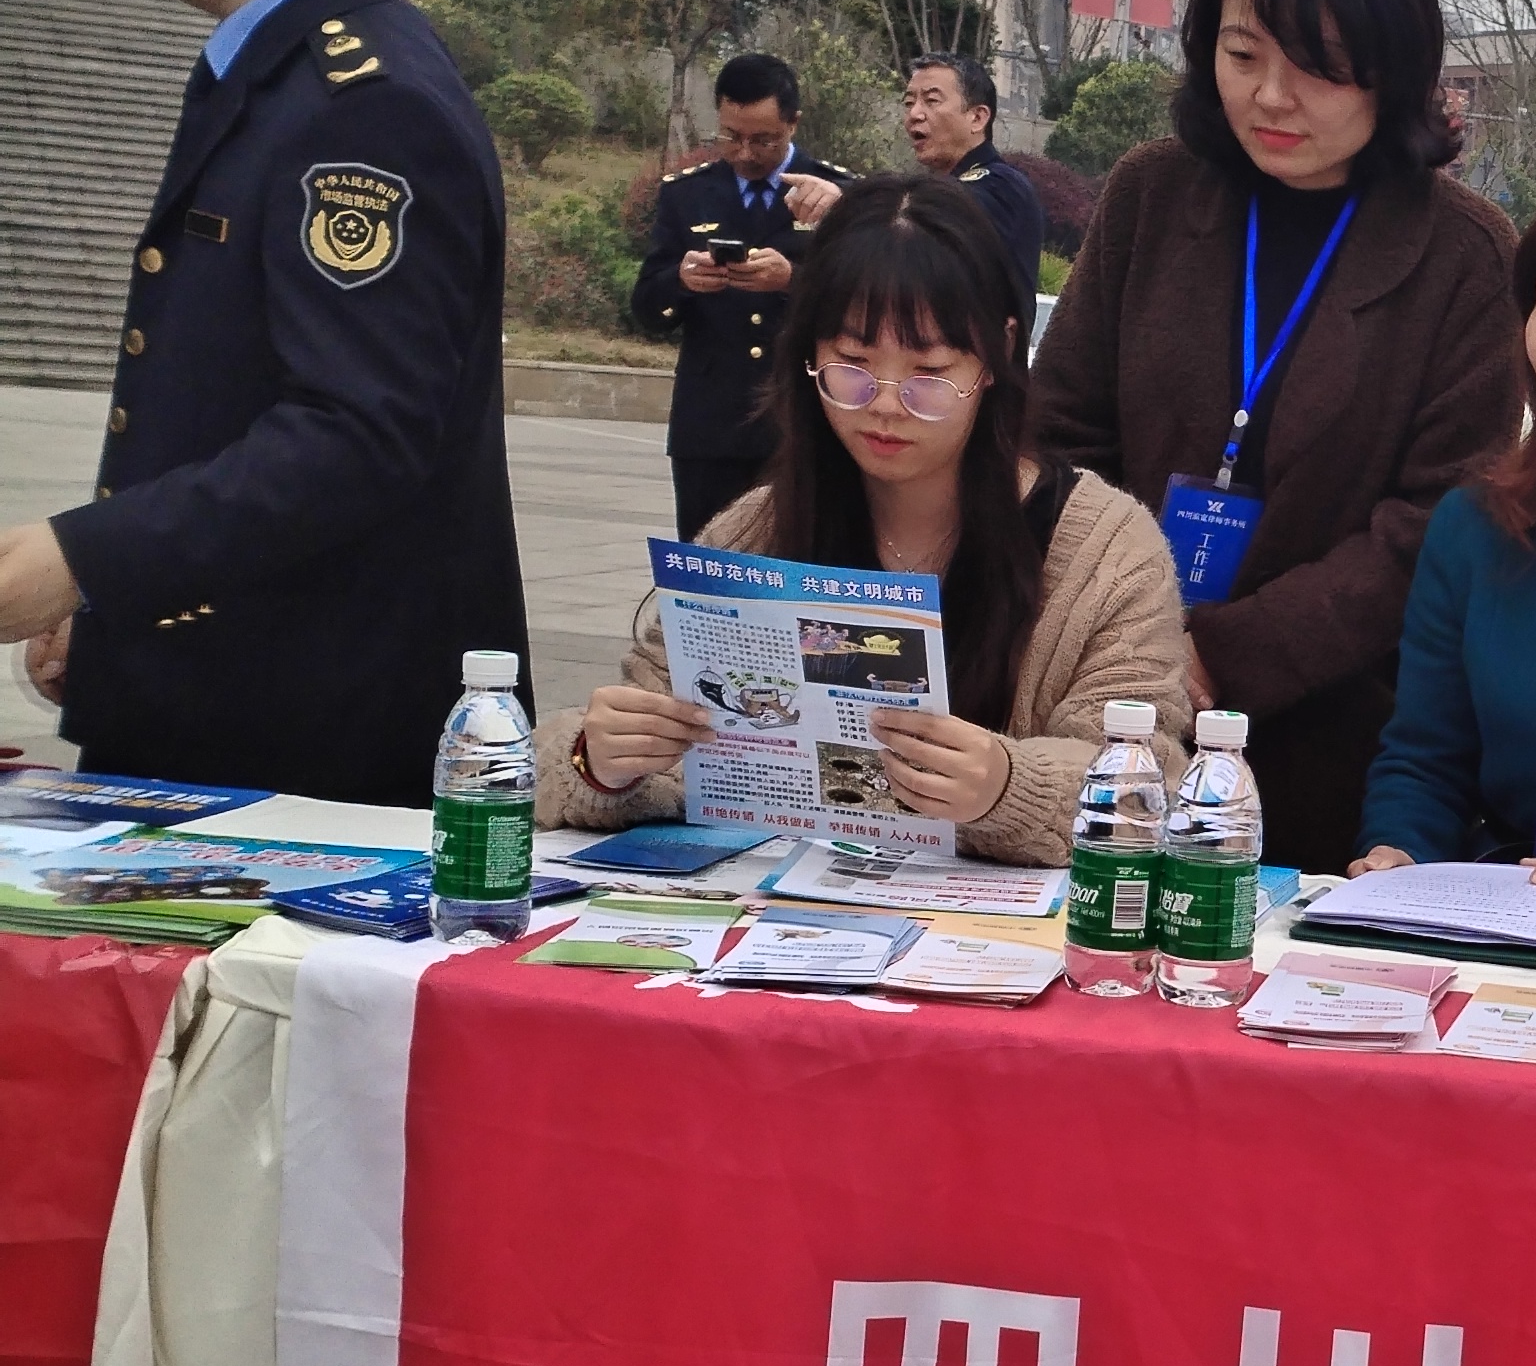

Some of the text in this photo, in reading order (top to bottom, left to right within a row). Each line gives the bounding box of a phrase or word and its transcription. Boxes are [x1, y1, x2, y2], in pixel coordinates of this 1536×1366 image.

[314, 174, 401, 202] 中华人民共和国
[666, 553, 924, 603] 共同防范传销 共建文明城市
[1190, 533, 1214, 584] 工作证
[703, 805, 754, 822] 拒绝传销
[763, 813, 816, 829] 从我做起
[828, 821, 881, 838] 举报传销
[890, 829, 941, 846] 人人有责
